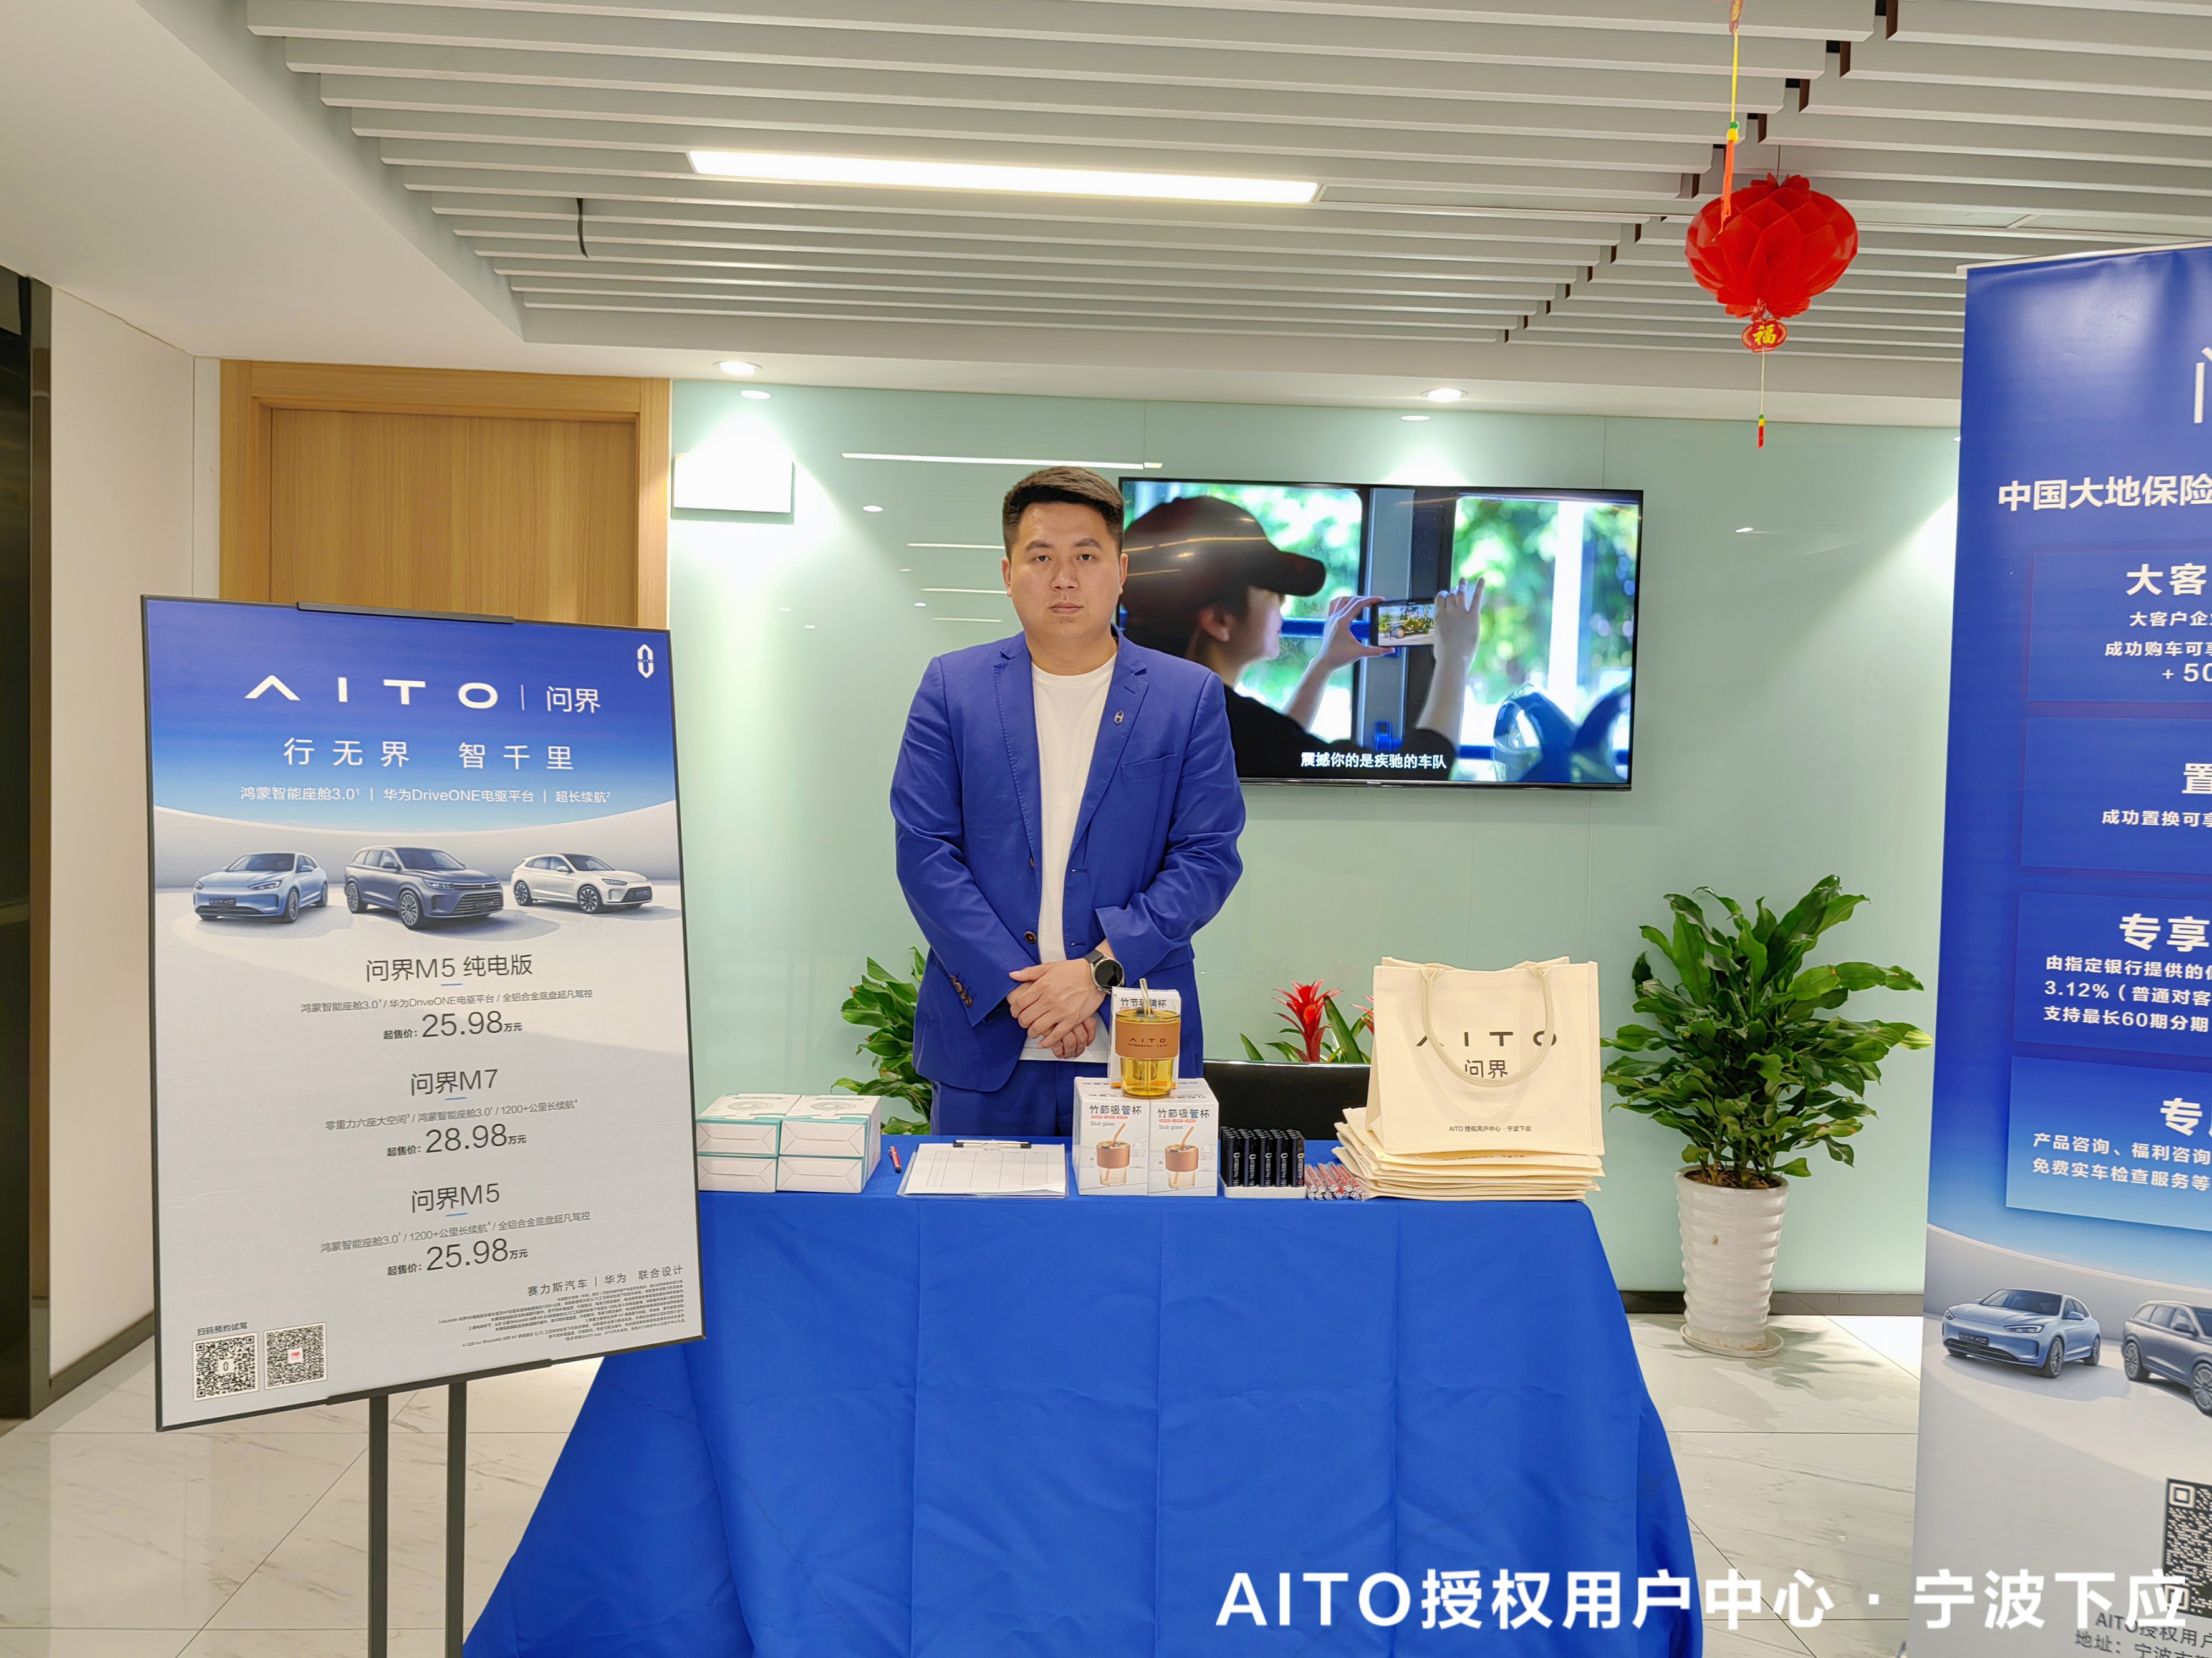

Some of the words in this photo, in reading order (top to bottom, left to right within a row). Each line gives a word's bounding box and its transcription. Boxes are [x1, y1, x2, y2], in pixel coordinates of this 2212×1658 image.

[1753, 324, 1777, 345] 福
[1998, 473, 2212, 511] 中国大地保险
[2126, 563, 2207, 595] 大客
[2129, 611, 2212, 626] 大客户企
[244, 674, 498, 709] AITO
[546, 686, 601, 714] 问界
[283, 737, 410, 767] 行无界
[458, 742, 574, 770] 智千里
[1301, 752, 1447, 769] 震撼你的是疾驰的车队
[2181, 763, 2212, 794] 置
[383, 788, 534, 803] 华为DriveONE电驱平台
[2119, 913, 2210, 952] 专享
[366, 957, 456, 982] 问界M5
[463, 954, 533, 977] 纯电版
[2044, 1005, 2208, 1032] 支持最长60期分期
[410, 1069, 498, 1096] 问界M7
[1465, 1060, 1508, 1078] 问界
[2160, 1098, 2212, 1138] 专
[2034, 1133, 2211, 1165] 产品咨询、福利咨询
[2032, 1157, 2210, 1191] 免费实车检查服务等
[411, 1183, 500, 1213] 问界M5
[527, 1278, 588, 1296] 赛力斯汽车
[604, 1273, 626, 1285] 华为
[638, 1265, 683, 1280] 联合设计
